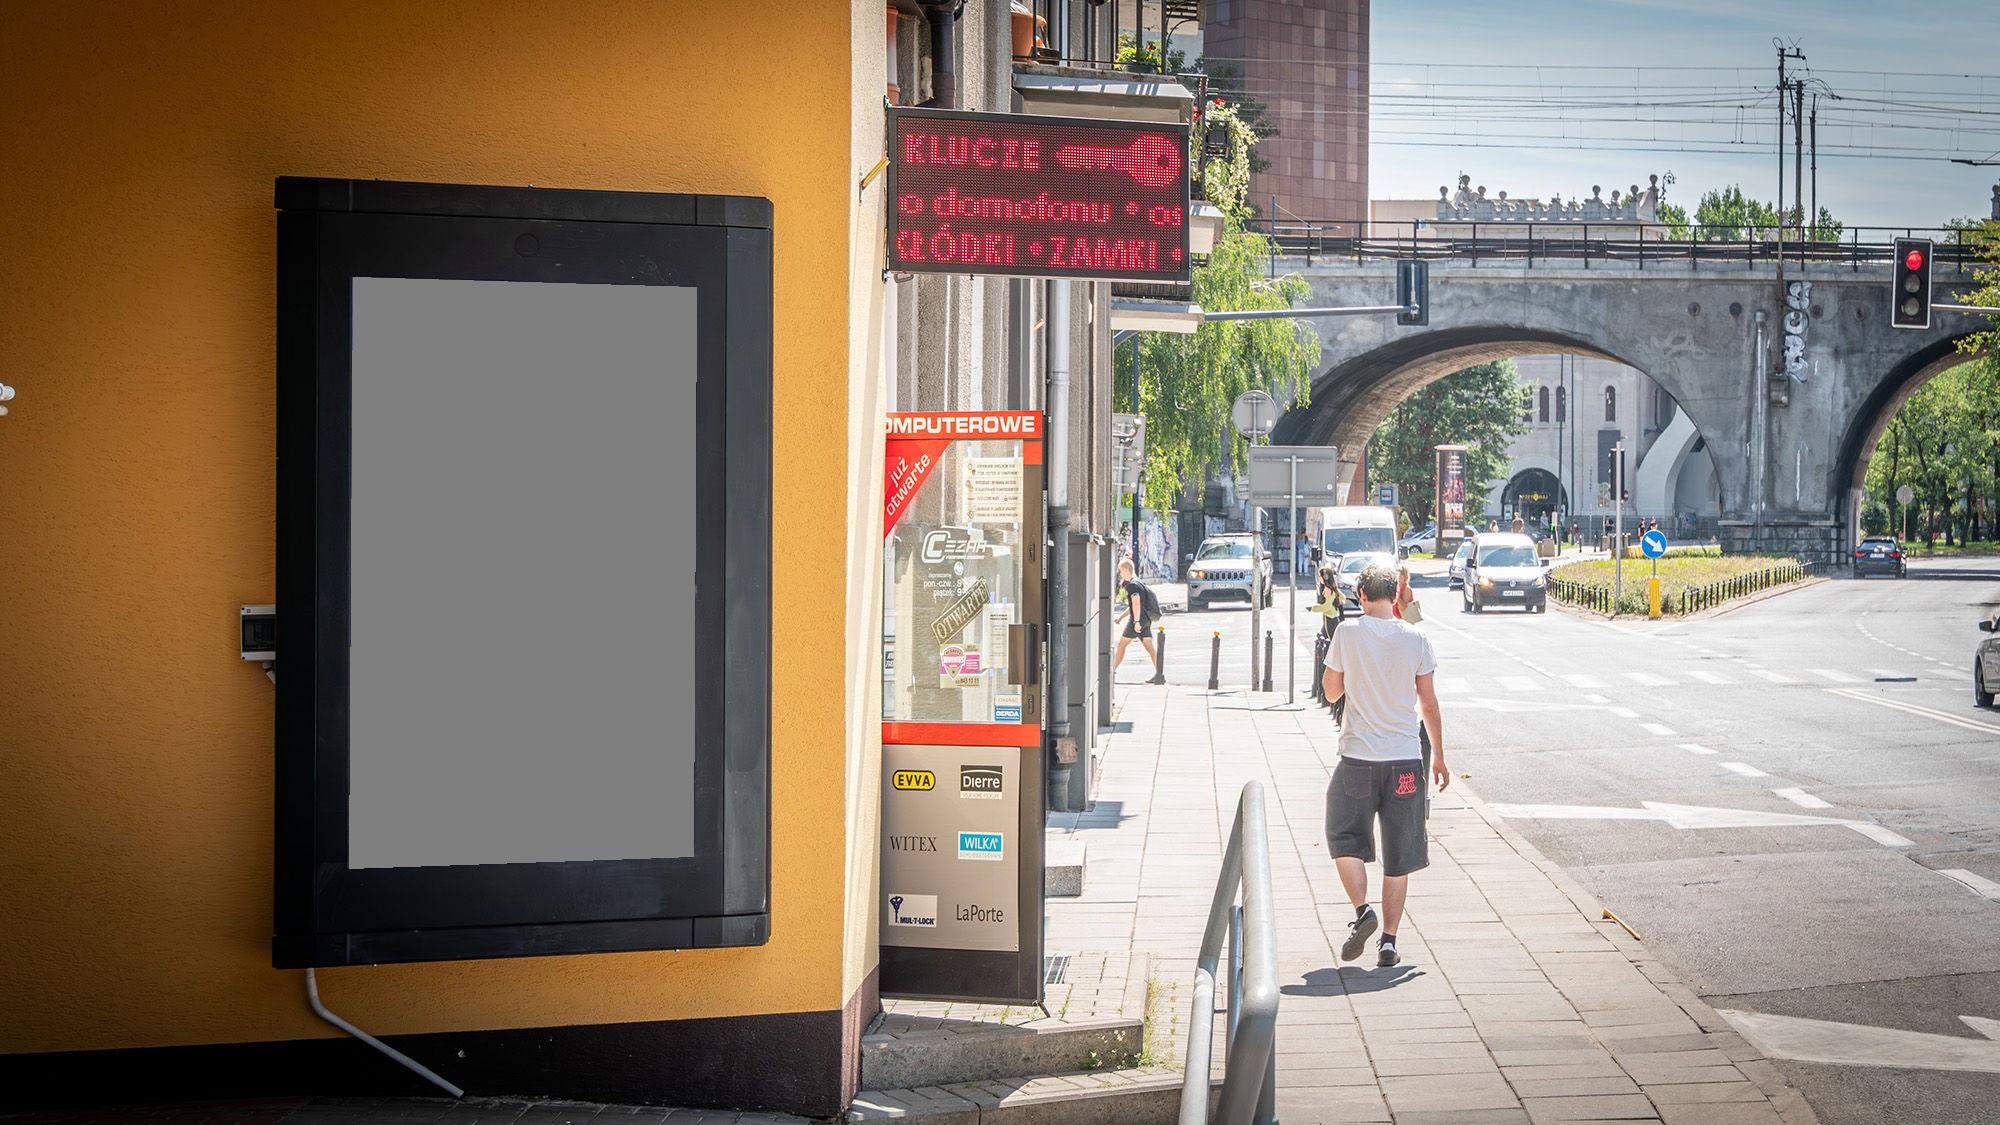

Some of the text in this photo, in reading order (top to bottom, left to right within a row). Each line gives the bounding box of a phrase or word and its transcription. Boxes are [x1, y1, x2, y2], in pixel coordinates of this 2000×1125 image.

[904, 134, 1040, 169] KLUCZE
[934, 187, 1110, 223] domofonu
[1050, 235, 1156, 270] ZAMKI
[886, 454, 930, 516] otwarte
[888, 456, 908, 488] już
[936, 582, 987, 639] OTWARTE
[897, 774, 931, 787] EVVA
[962, 775, 1000, 788] Dierre
[890, 836, 937, 852] WITEX
[900, 917, 935, 925] MUL-T-LOCK
[956, 904, 1004, 922] LaPorte
